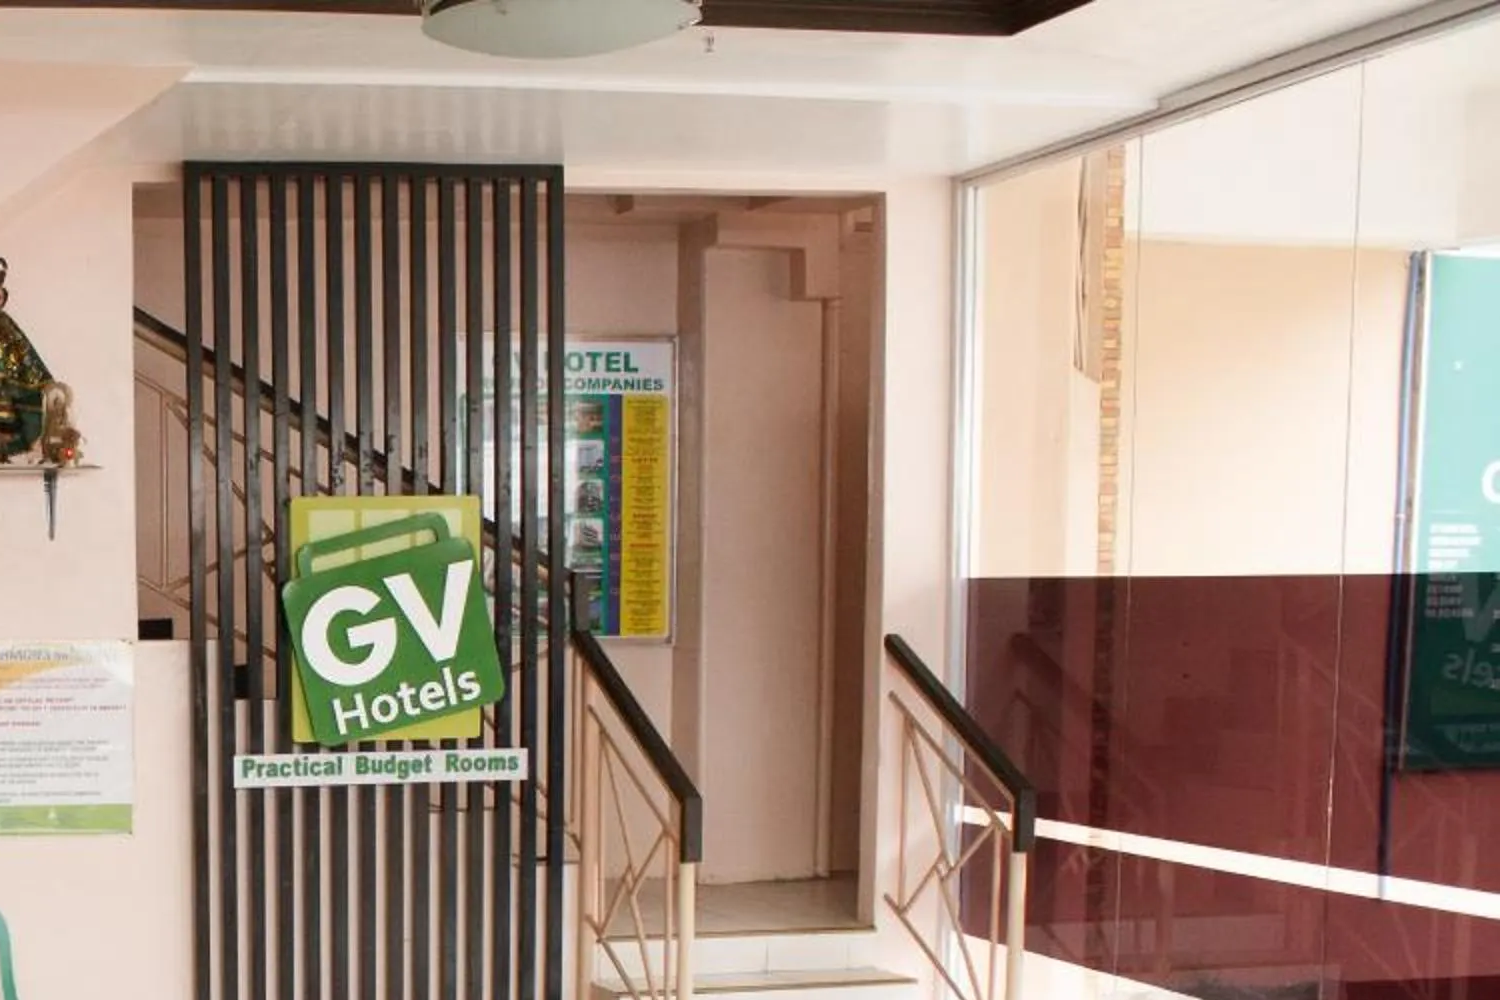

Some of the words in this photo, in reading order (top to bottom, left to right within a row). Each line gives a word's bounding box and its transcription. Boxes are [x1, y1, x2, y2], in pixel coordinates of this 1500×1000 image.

[545, 351, 639, 373] OTEL
[563, 377, 664, 392] COMPANIES
[301, 559, 473, 687] GV
[331, 667, 482, 735] Hotels
[241, 756, 343, 779] Practical
[355, 754, 433, 780] Budget
[445, 753, 520, 773] Rooms
